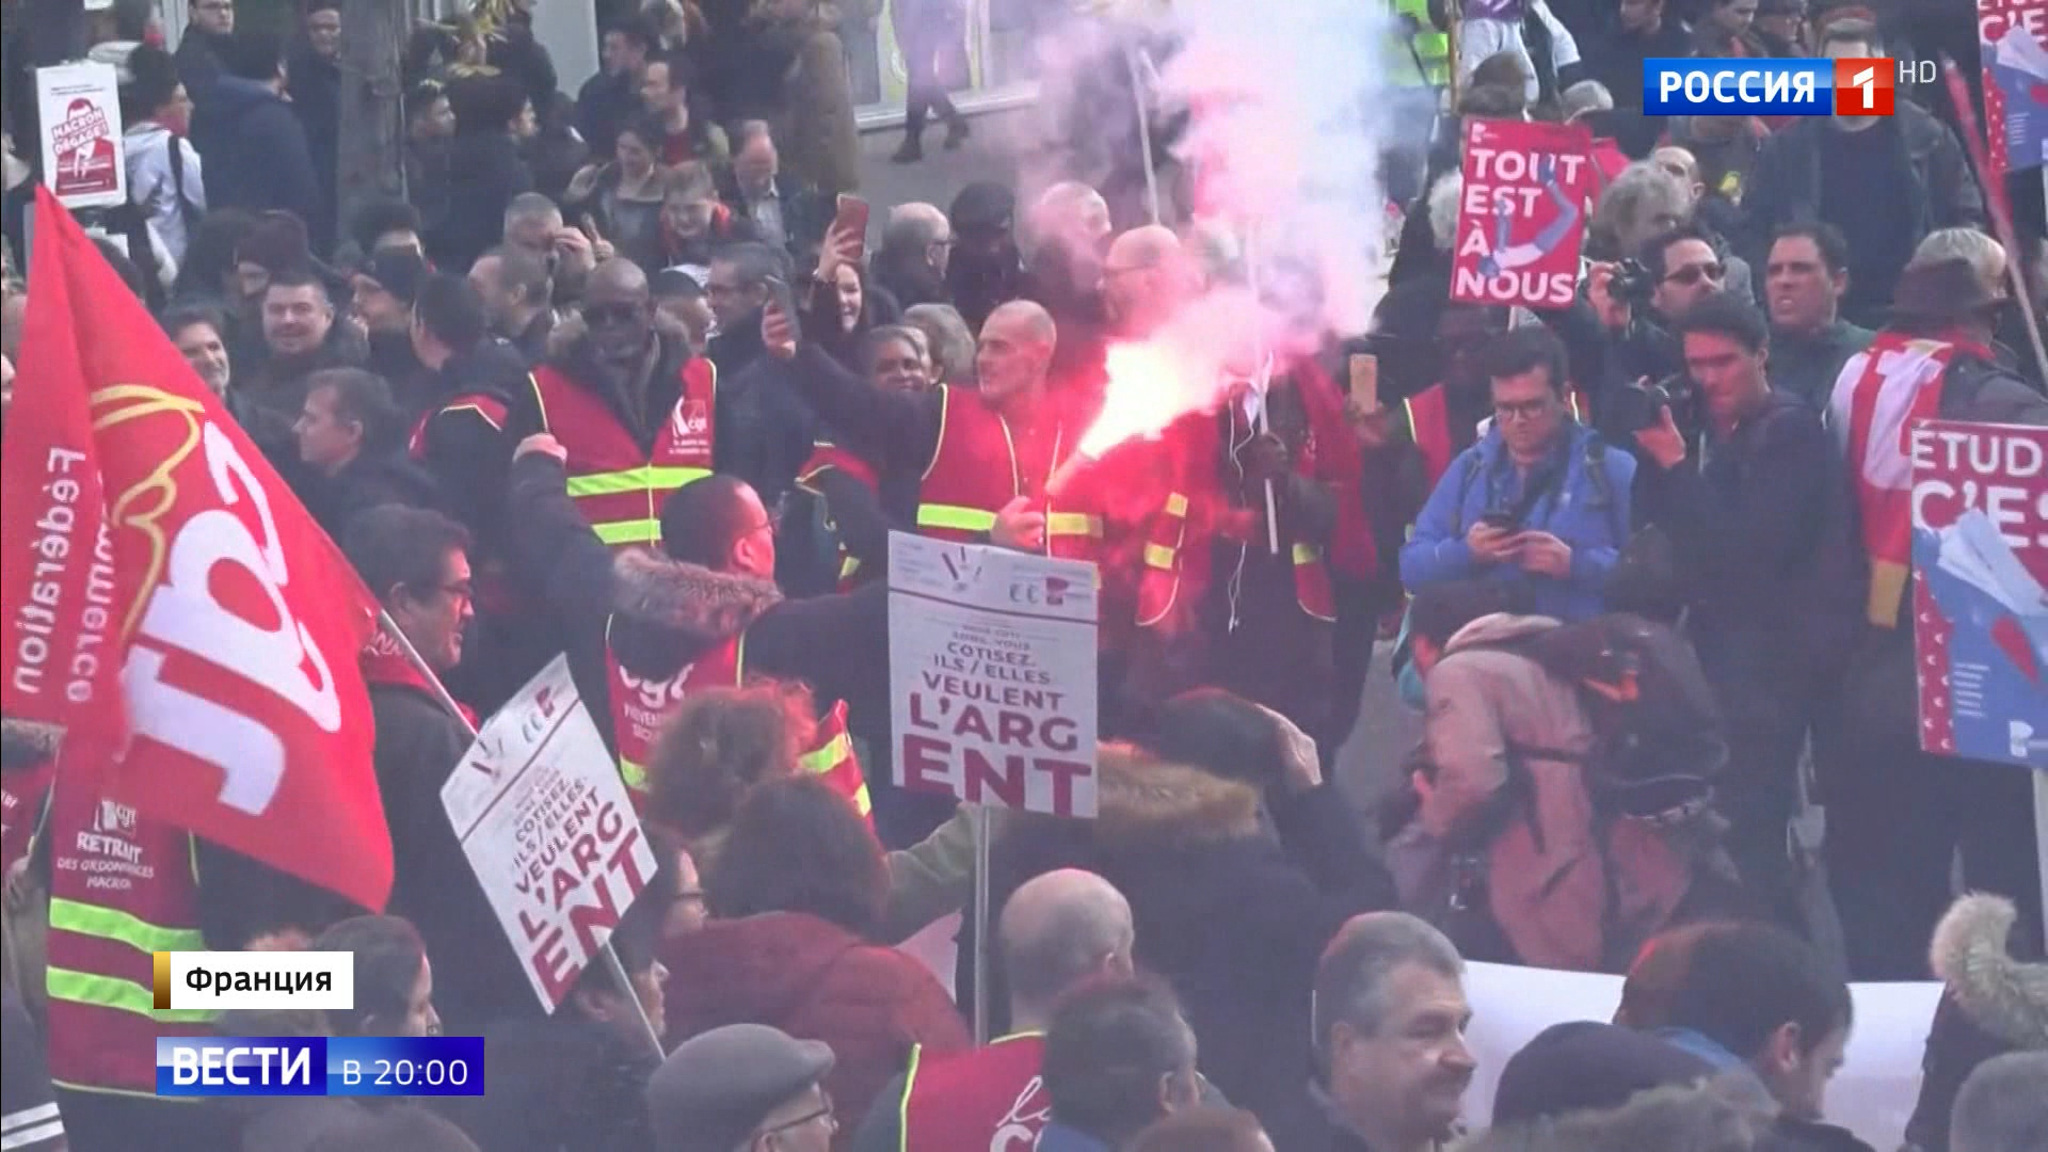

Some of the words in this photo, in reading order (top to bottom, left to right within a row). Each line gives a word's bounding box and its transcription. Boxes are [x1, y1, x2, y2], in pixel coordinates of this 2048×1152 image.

[1470, 148, 1586, 185] TOUT
[1464, 184, 1543, 218] EST
[1459, 219, 1491, 257] À
[1455, 266, 1573, 303] NOUS
[1911, 480, 2048, 548] C'E
[922, 671, 1065, 711] VEULENT
[934, 654, 965, 672] ILS
[985, 664, 1051, 685] ELLES
[910, 692, 1078, 752] L'ARG
[903, 733, 1092, 819] ENT
[514, 841, 537, 868] ILS
[544, 778, 585, 829] ELLES
[515, 786, 600, 894] VEULENT
[57, 857, 78, 871] DES
[519, 801, 622, 942] L'ARG
[532, 827, 647, 1006] ENT
